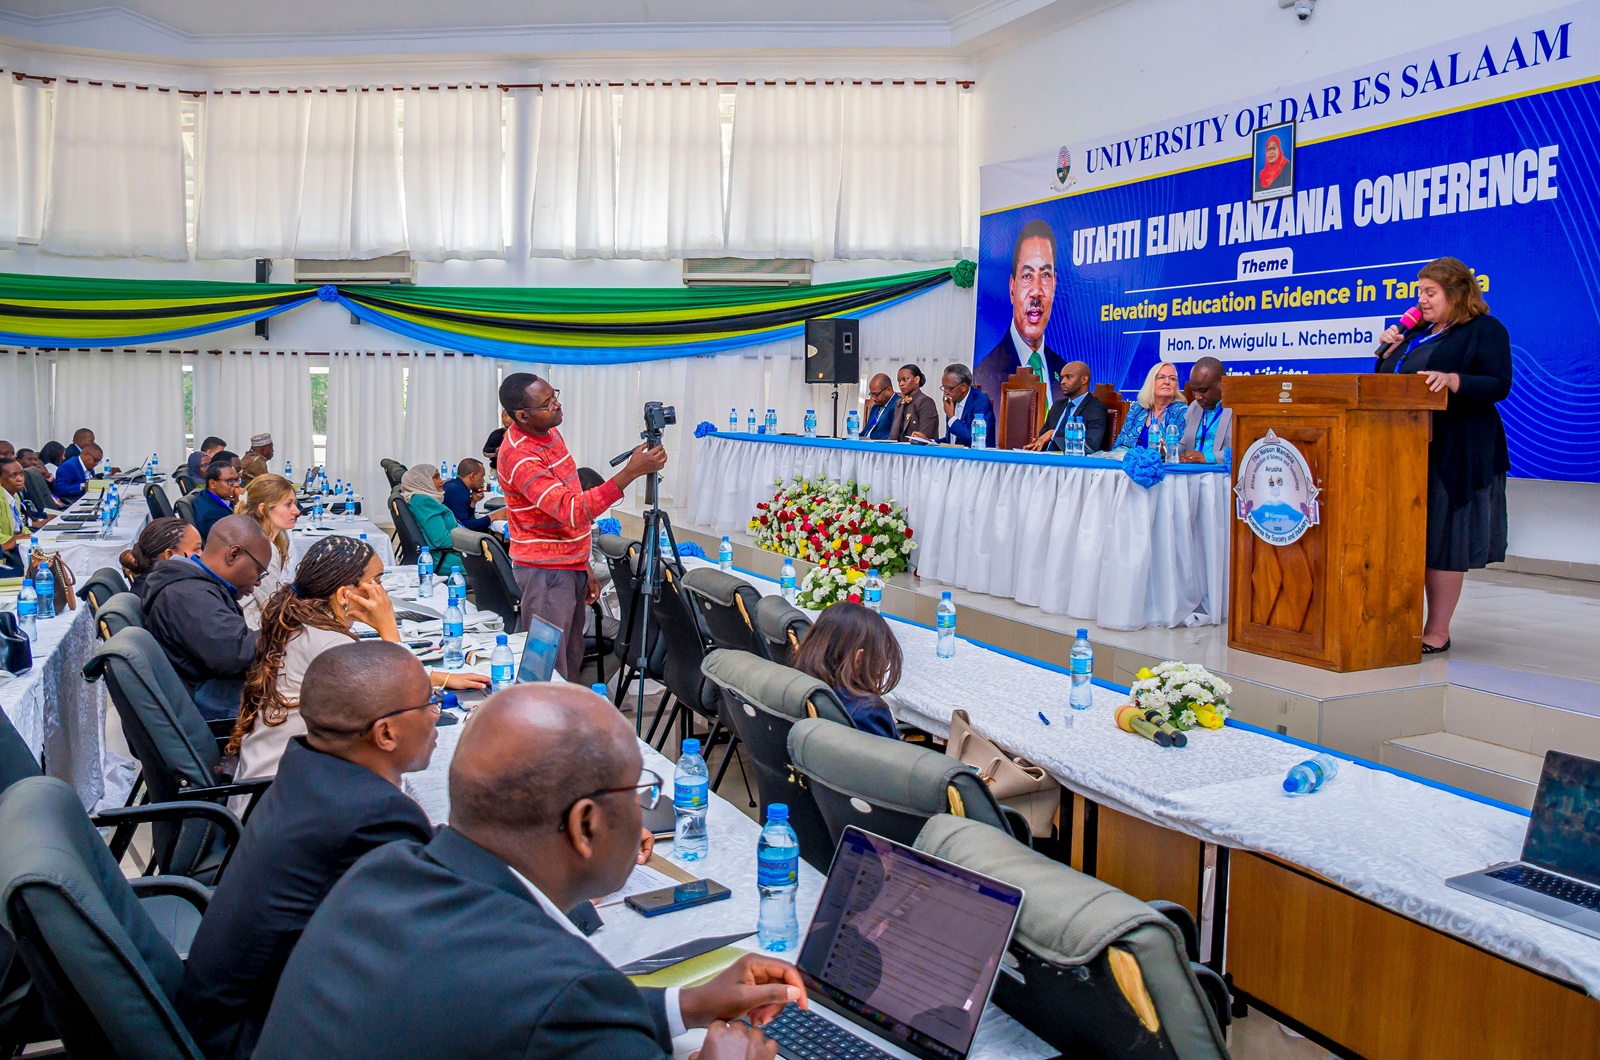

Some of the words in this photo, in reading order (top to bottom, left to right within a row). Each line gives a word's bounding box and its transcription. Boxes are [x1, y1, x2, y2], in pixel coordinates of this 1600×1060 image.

[1085, 114, 1229, 173] UNIVERSITY
[1235, 103, 1272, 137] OF
[1279, 86, 1342, 123] DAR
[1351, 71, 1391, 110] ES
[1400, 22, 1573, 99] SALAAM
[1072, 219, 1141, 267] UTAFITI
[1146, 207, 1209, 257] ELIMU
[1216, 184, 1343, 246] TANZANIA
[1353, 144, 1559, 227] CONFERENCE
[1242, 258, 1289, 274] Theme
[1101, 299, 1168, 322] Elevating
[1171, 291, 1256, 316] Education
[1261, 286, 1351, 310] Evidence
[1356, 279, 1376, 302] in
[1382, 267, 1490, 300] Tana
[1167, 337, 1194, 351] Hon.
[1198, 336, 1215, 350] Dr.
[1219, 332, 1277, 352] Mwigulu
[1282, 332, 1294, 347] L.
[1298, 327, 1373, 346] Nchemba
